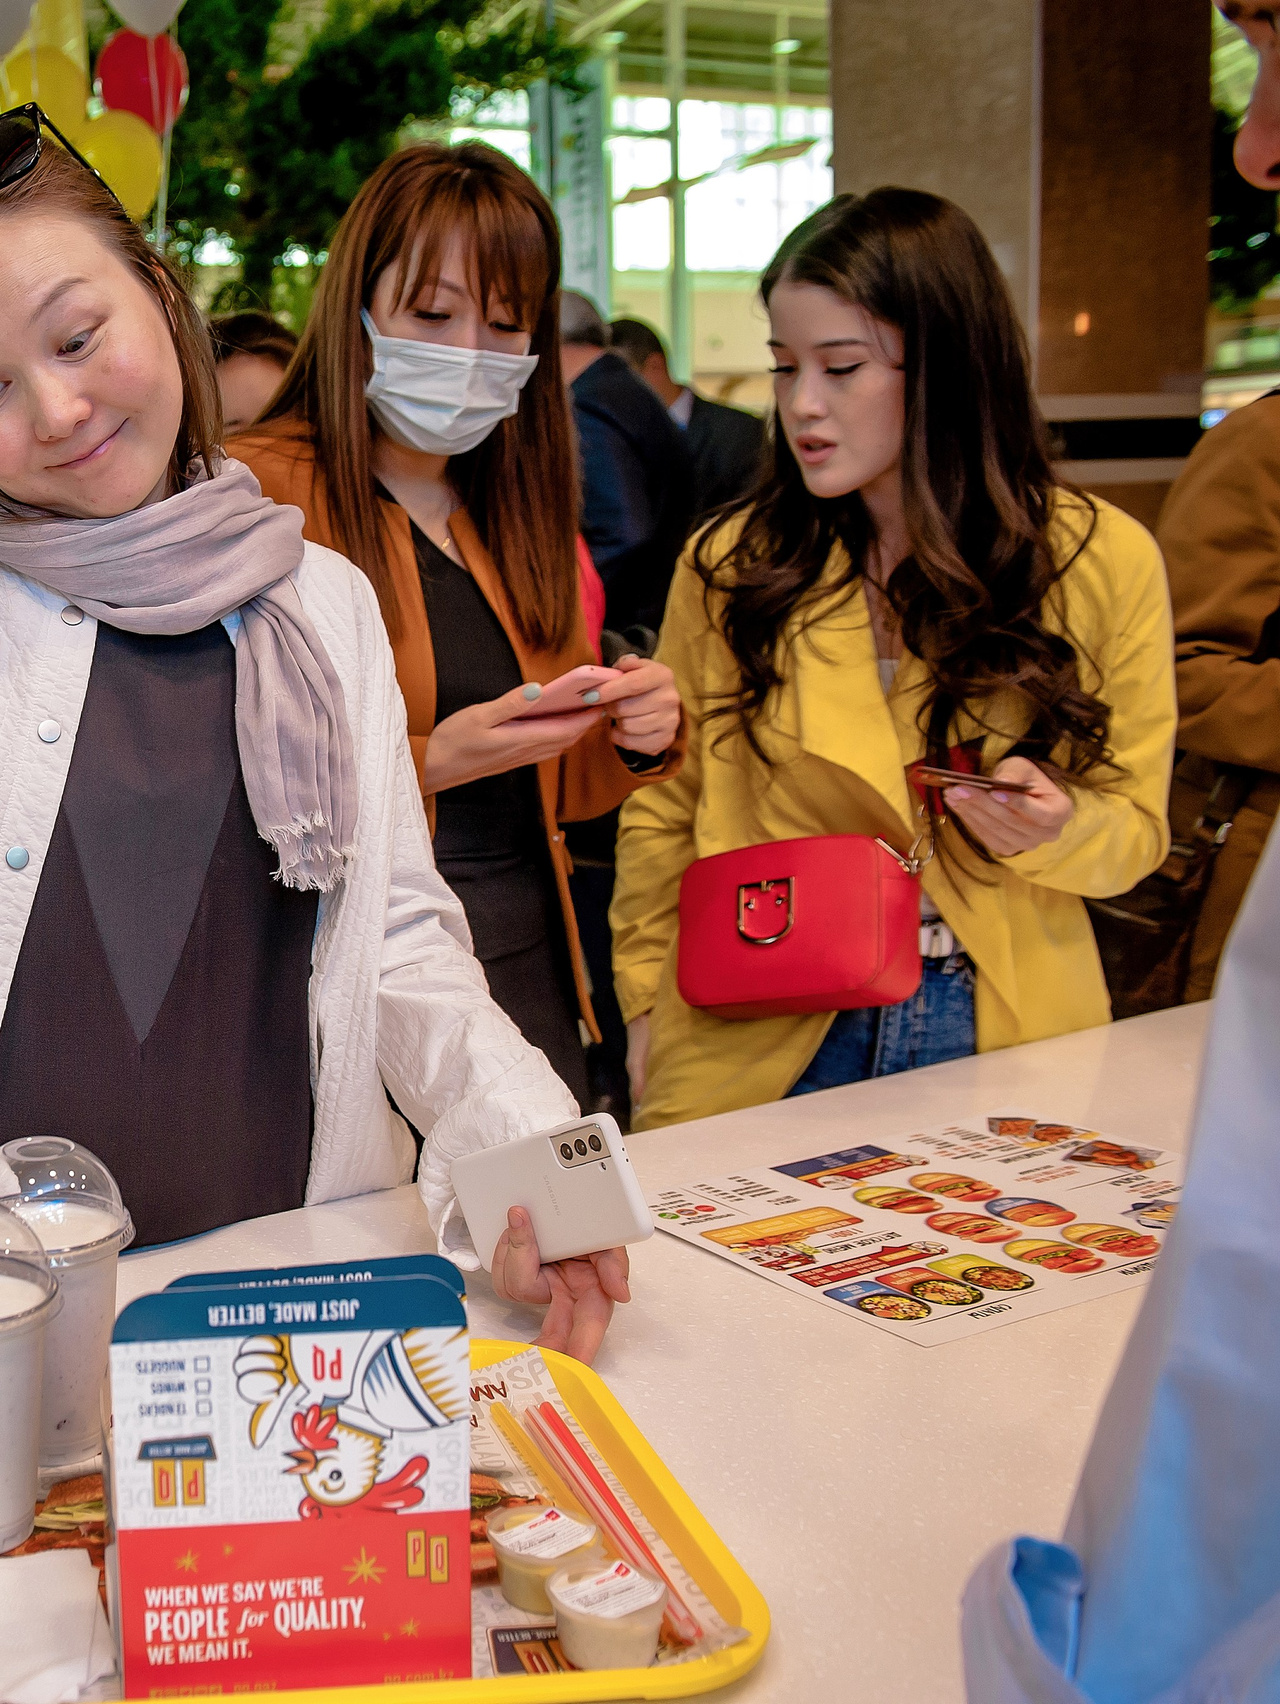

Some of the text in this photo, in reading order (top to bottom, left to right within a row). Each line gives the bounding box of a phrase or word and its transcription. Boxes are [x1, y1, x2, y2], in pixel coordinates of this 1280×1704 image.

[542, 1173, 562, 1217] SAMSUNG
[823, 1232, 903, 1254] ДЕТСКОЕ МЕНЮ
[207, 1299, 360, 1327] JUST MADE, BETTER
[967, 1304, 1013, 1319] САЛАТЫ
[136, 1357, 186, 1373] NUGGETS
[312, 1345, 342, 1381] PQ
[151, 1381, 186, 1395] WINGS
[139, 1402, 187, 1417] TENDERS
[144, 1576, 324, 1608] WHEN WE SAY WE'RE
[144, 1607, 229, 1643] PEOPLE
[236, 1611, 269, 1635] for
[147, 1638, 253, 1666] WE MEAN IT.
